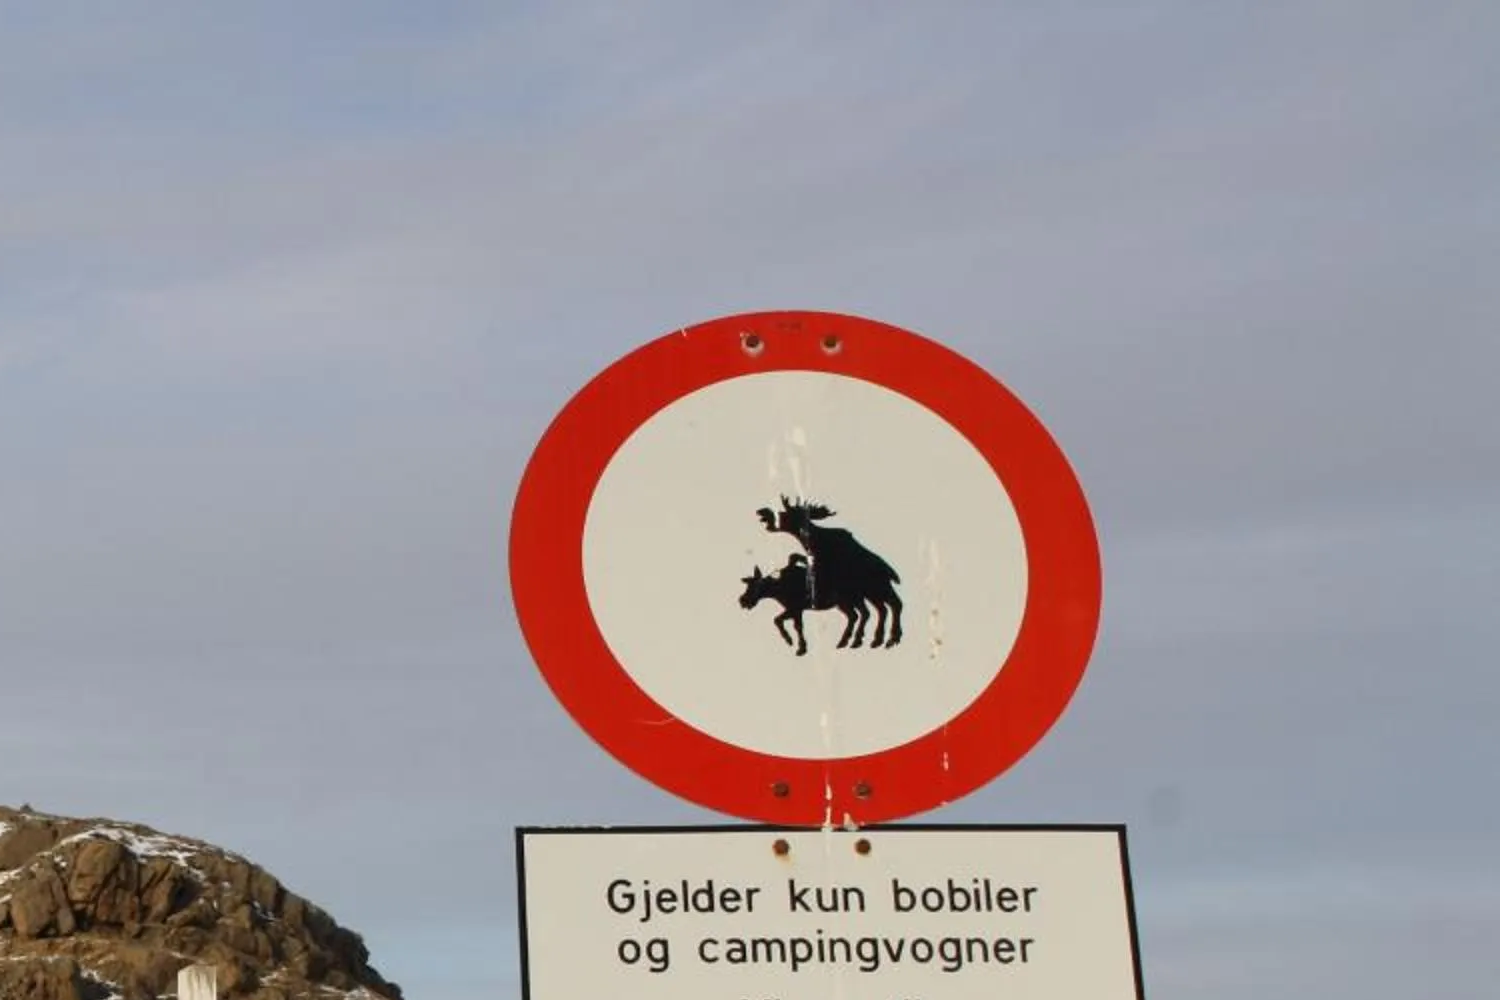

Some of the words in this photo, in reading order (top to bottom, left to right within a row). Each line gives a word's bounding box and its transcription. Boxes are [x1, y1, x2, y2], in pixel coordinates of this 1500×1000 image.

[606, 879, 761, 923] Gjelder
[788, 878, 866, 913] kun
[891, 877, 1038, 913] bobiler
[617, 938, 670, 974] og
[698, 929, 1034, 973] campingvogner
